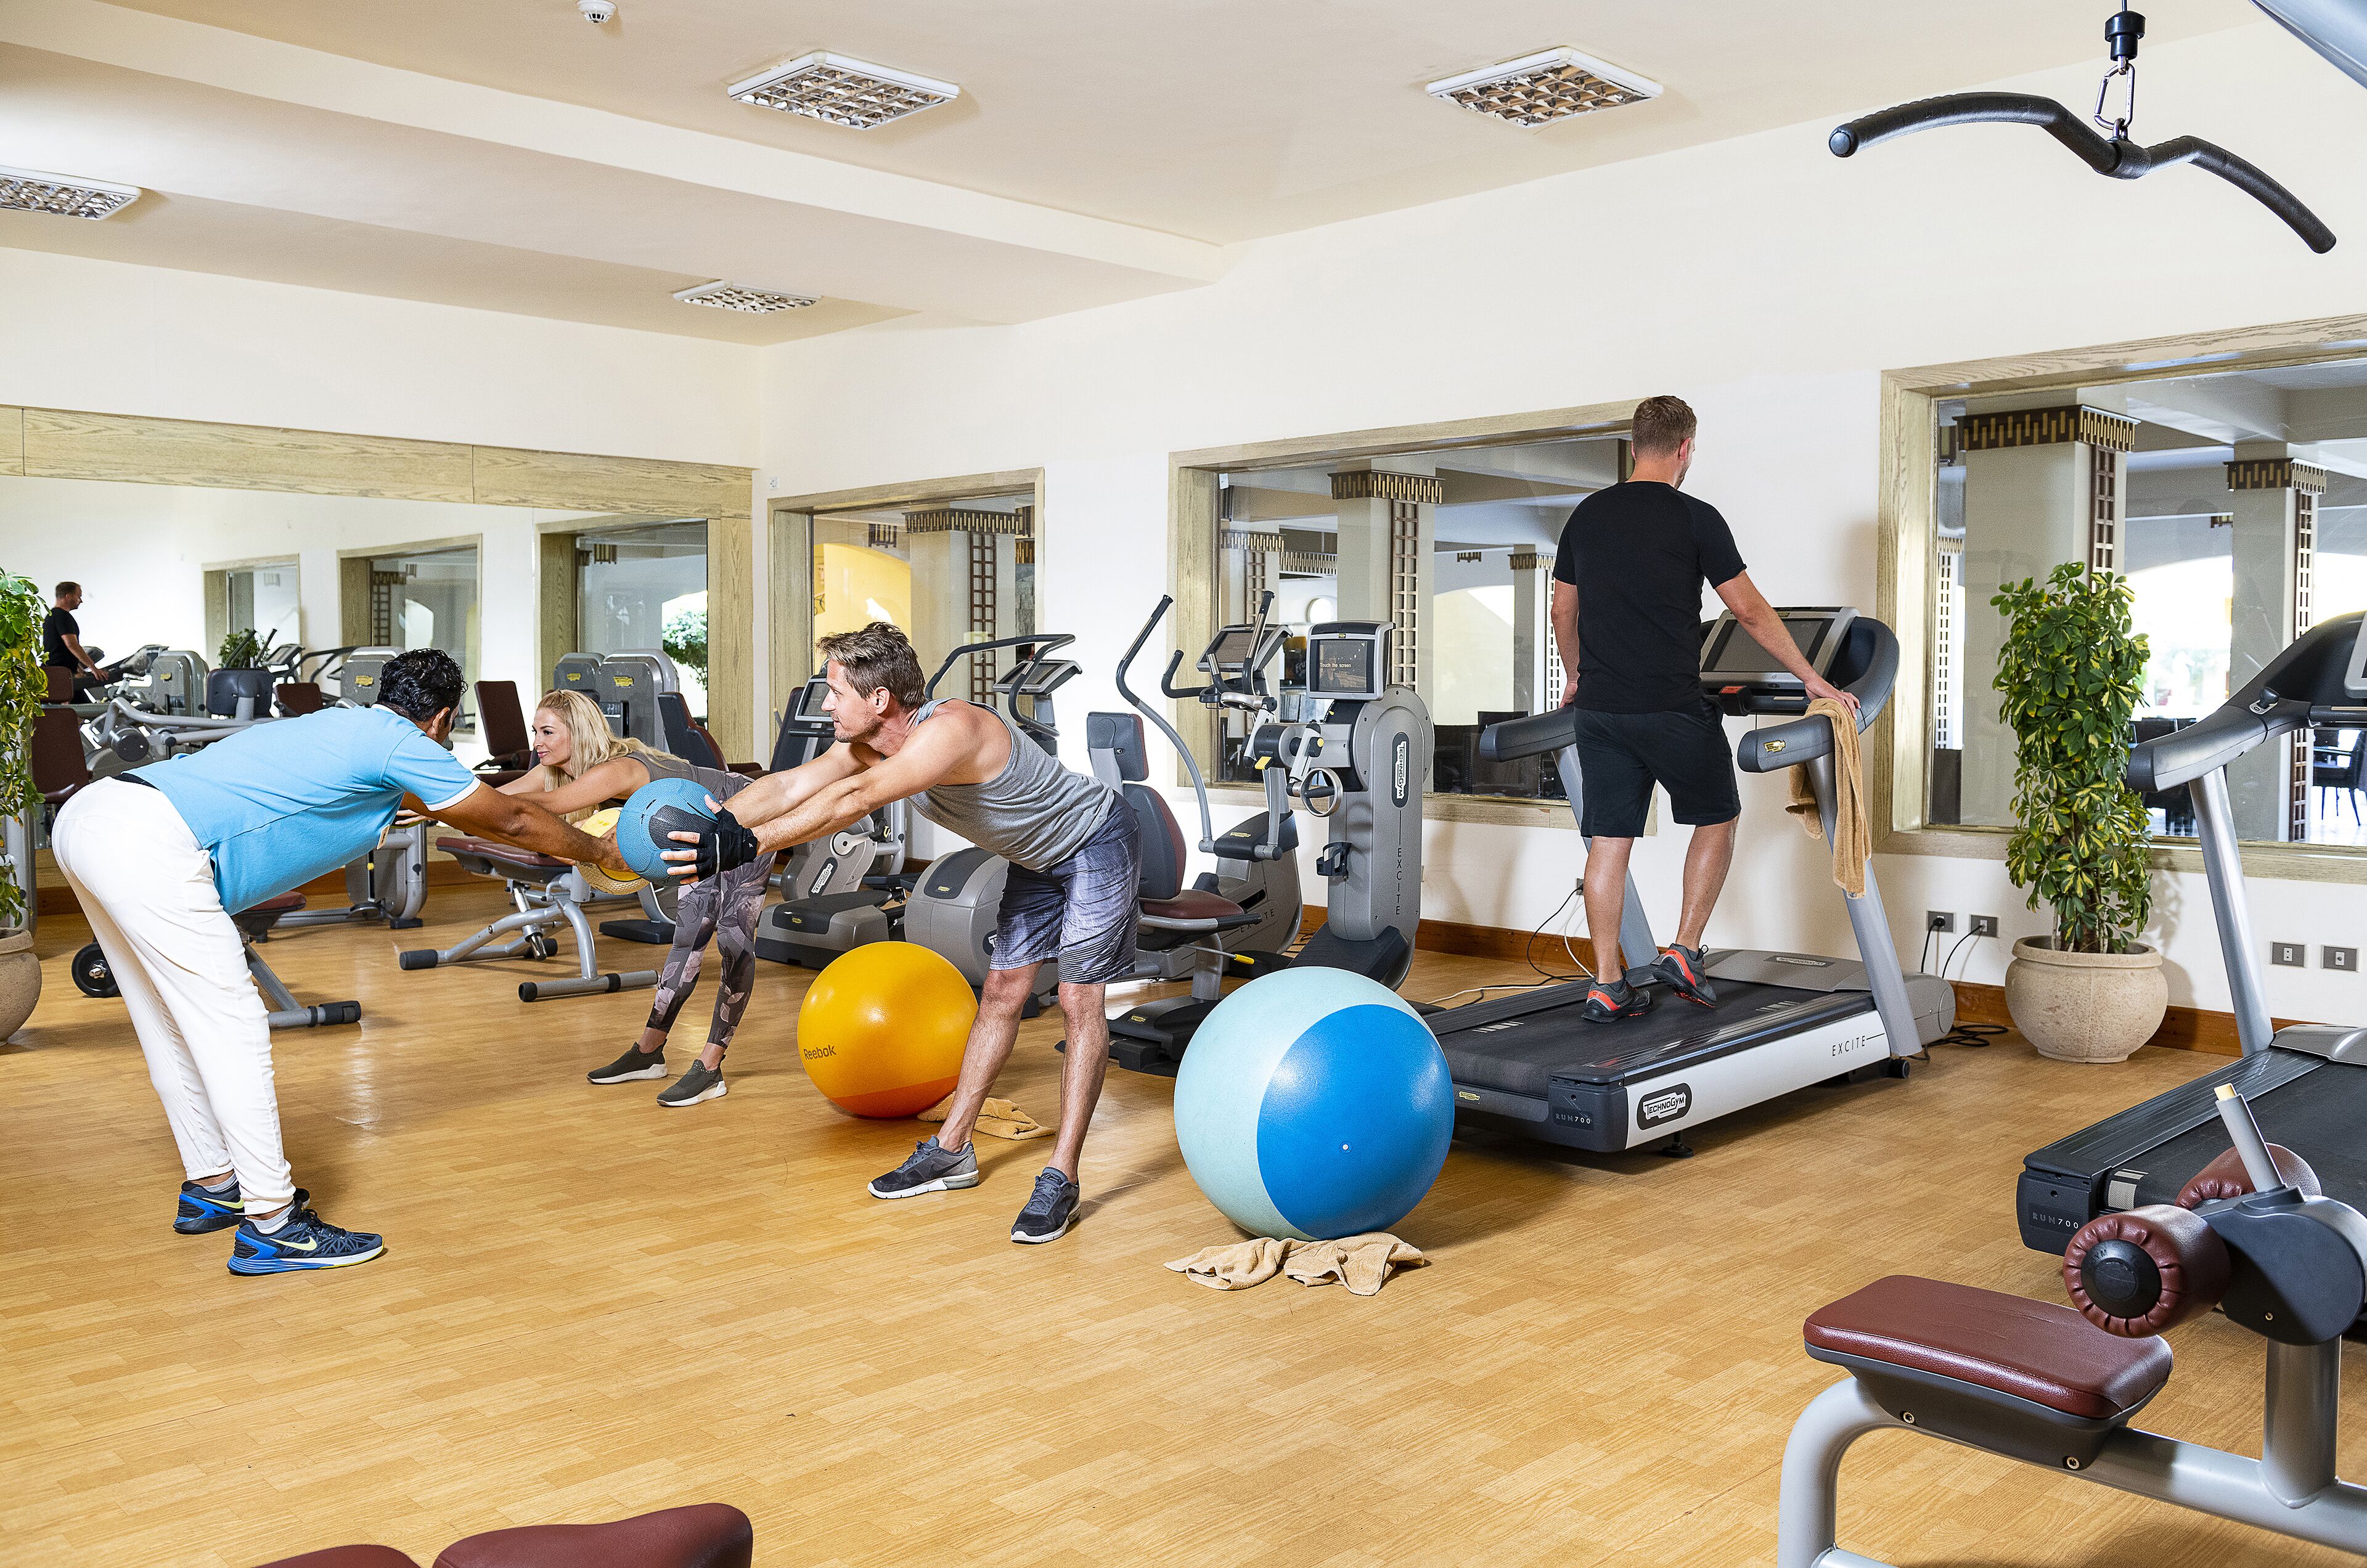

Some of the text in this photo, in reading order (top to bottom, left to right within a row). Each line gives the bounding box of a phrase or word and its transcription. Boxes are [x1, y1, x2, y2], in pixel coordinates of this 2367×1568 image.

[1240, 909, 1275, 933] EXTE
[803, 1045, 836, 1060] Reebok
[1832, 1035, 1865, 1056] EXCITE
[1644, 1095, 1685, 1116] TECHNOGYM
